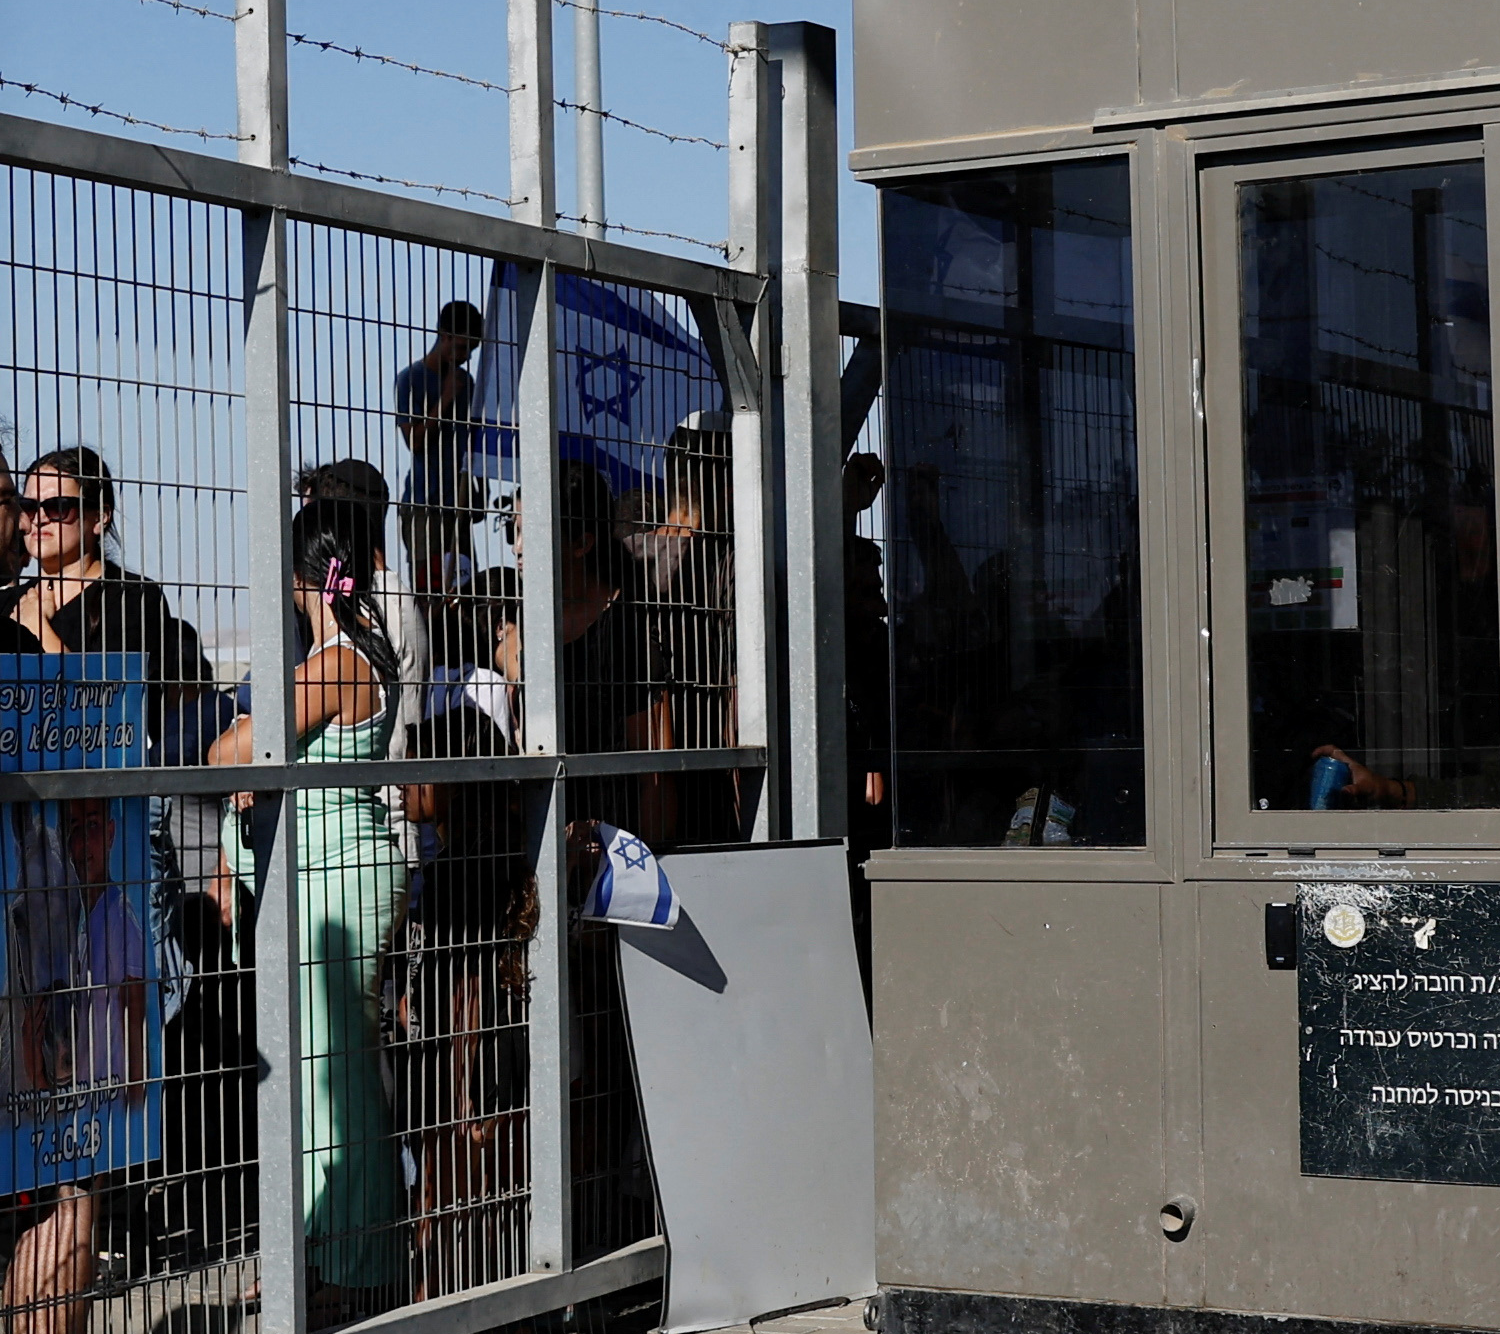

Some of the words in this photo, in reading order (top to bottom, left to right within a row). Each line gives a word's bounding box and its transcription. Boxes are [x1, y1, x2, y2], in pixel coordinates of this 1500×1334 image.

[1352, 969, 1408, 993] להציג
[1414, 975, 1465, 993] חובה
[1339, 1029, 1402, 1048] עבודה
[1407, 1031, 1477, 1050] וכרטיס
[1372, 1083, 1439, 1105] למחנה
